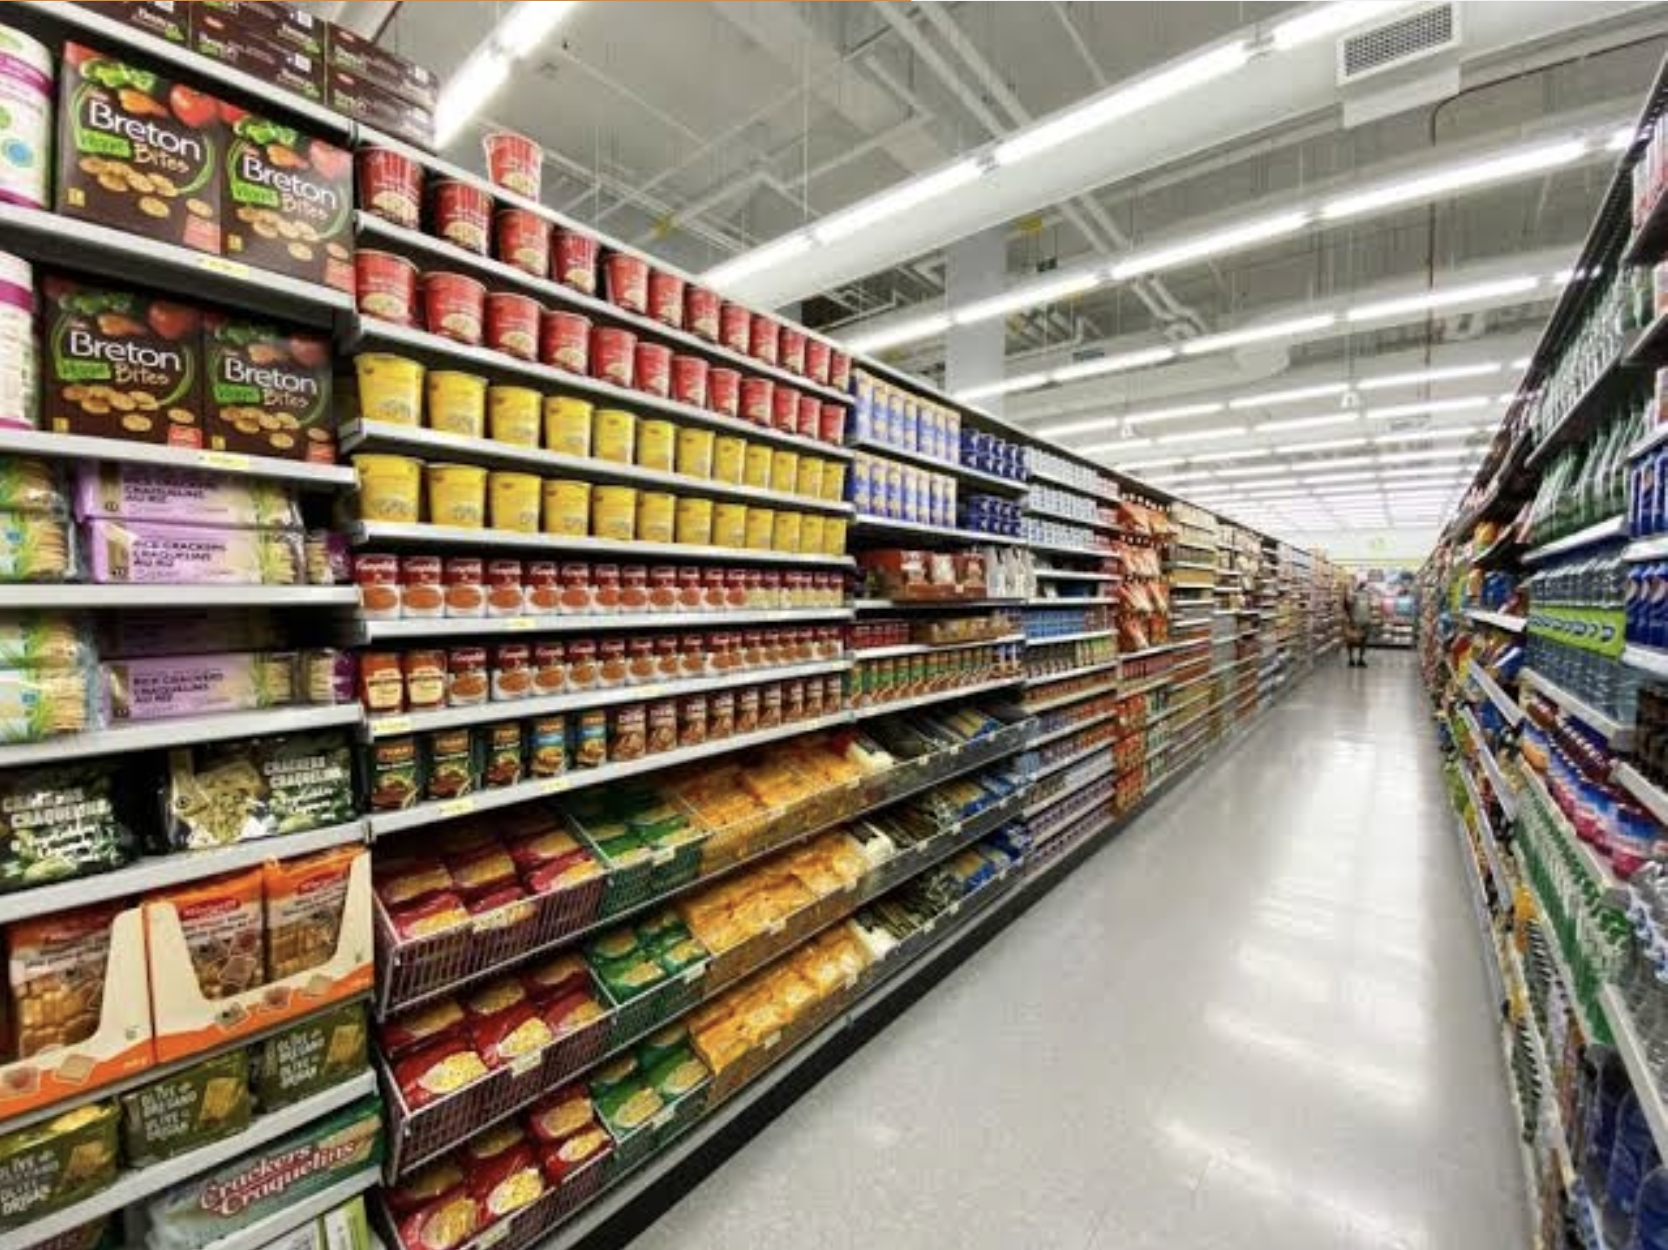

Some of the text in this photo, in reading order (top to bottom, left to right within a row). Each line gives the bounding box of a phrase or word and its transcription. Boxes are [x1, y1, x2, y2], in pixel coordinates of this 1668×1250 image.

[89, 99, 200, 161] Breton
[134, 142, 189, 172] Bites
[243, 155, 337, 211] Breton
[70, 330, 181, 372] Breton
[115, 362, 169, 384] Bites
[225, 357, 318, 395] Breton
[263, 388, 309, 408] Bites
[200, 1145, 312, 1212] Crackers
[221, 1141, 355, 1215] Craquelins
